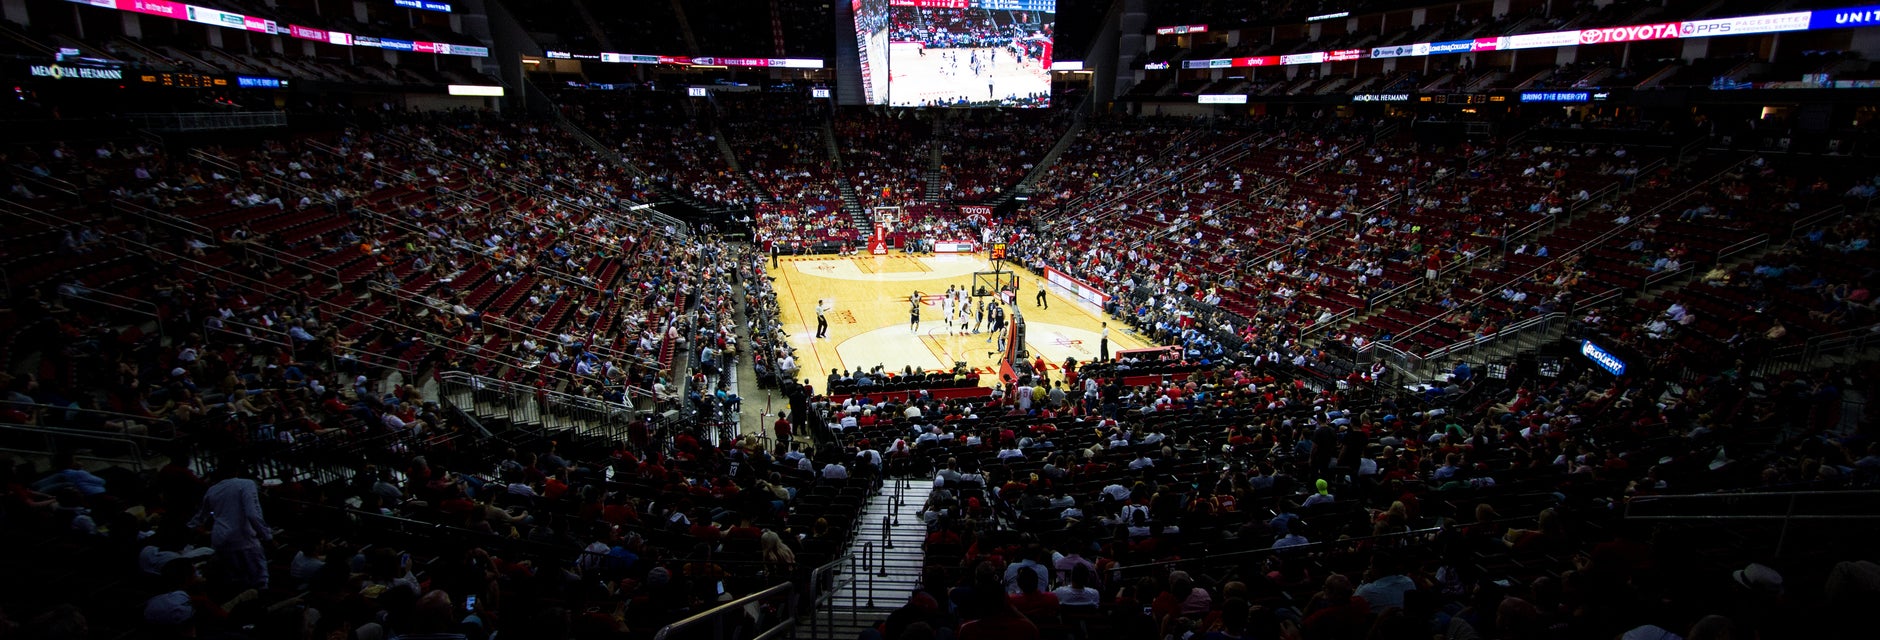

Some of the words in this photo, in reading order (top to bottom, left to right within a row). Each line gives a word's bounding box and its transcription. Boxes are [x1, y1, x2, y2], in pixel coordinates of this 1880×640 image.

[1735, 15, 1809, 26] PACESETTER
[1602, 24, 1679, 42] TOYOTA
[1697, 23, 1731, 34] PPS
[725, 58, 757, 66] ROCKETS.COM
[1145, 62, 1164, 70] reliant
[1247, 57, 1264, 66] xfinity
[31, 64, 80, 79] MEMORIAL
[80, 68, 122, 79] HERMANN
[1354, 93, 1379, 102] MEMORIAL
[1380, 93, 1409, 101] HERMANN
[1522, 93, 1543, 101] BRING
[1543, 93, 1556, 101] THE
[992, 250, 1004, 259] 24
[1586, 344, 1602, 359] BUD
[1599, 353, 1623, 371] LIGHT
